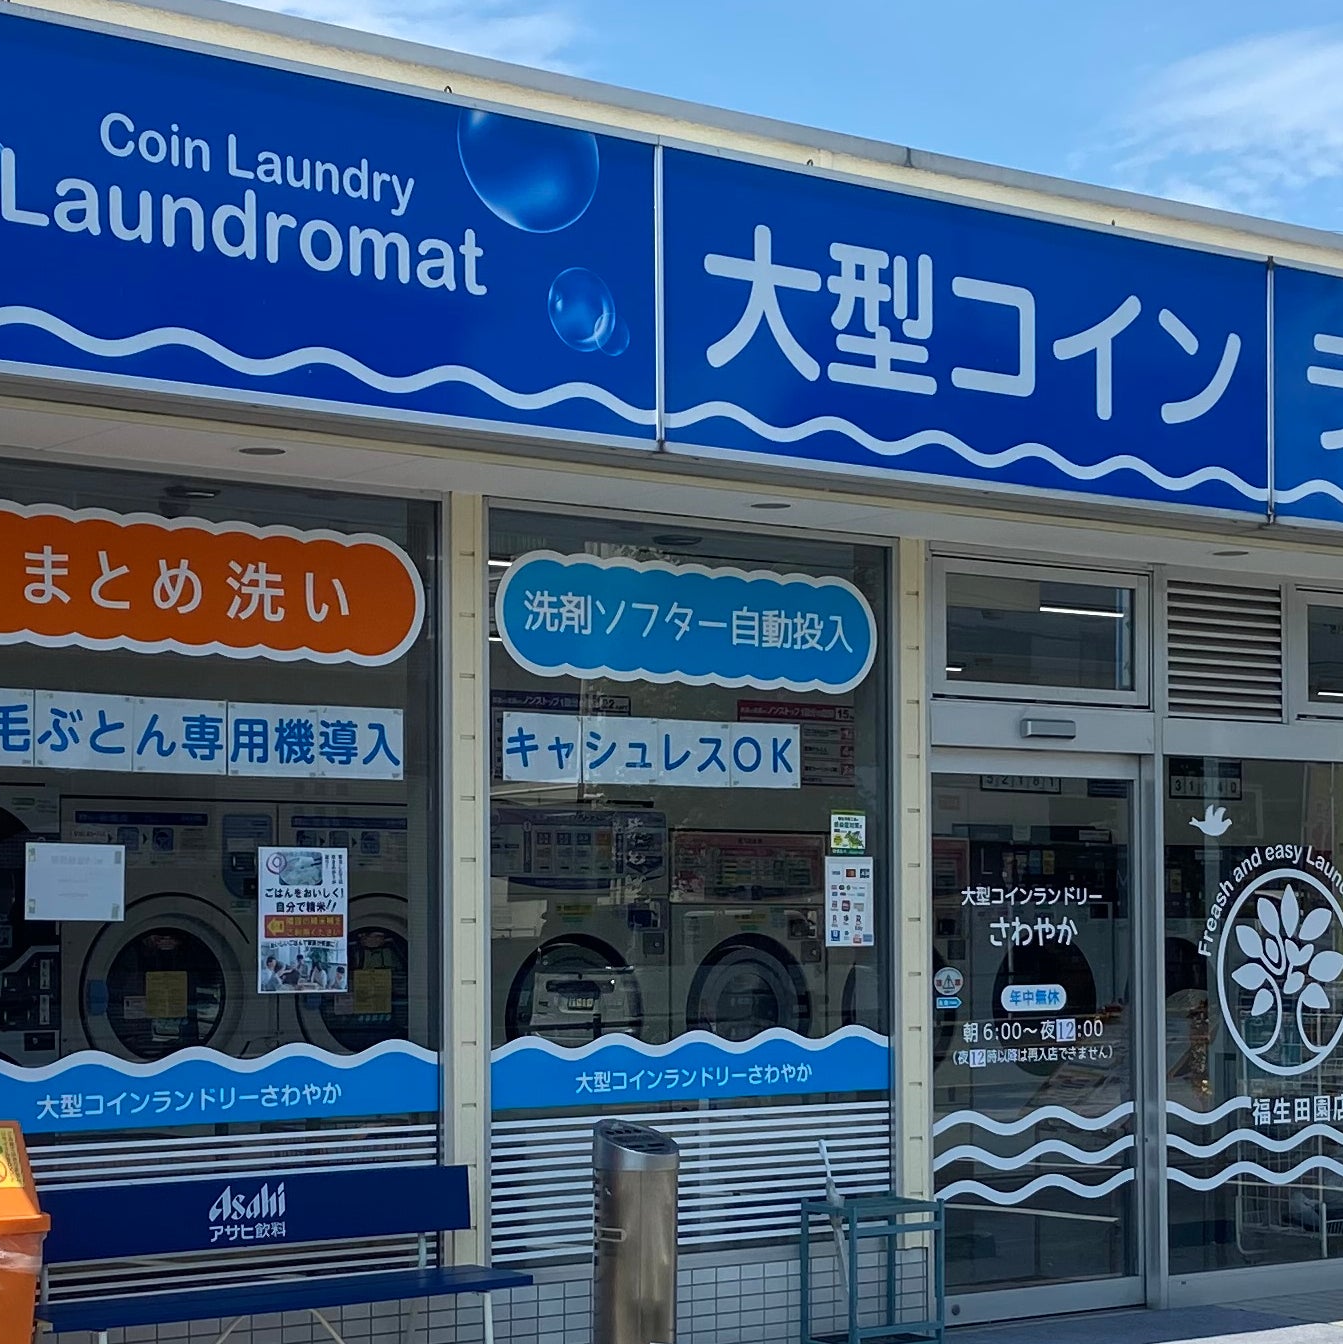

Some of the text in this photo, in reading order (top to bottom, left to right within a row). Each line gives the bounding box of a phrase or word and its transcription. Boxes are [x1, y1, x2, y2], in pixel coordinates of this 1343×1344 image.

[99, 111, 415, 217] Coin Laundry
[0, 146, 489, 297] Laundromat
[702, 223, 1244, 427] 大型コイン
[23, 545, 351, 624] まとめ洗い
[523, 588, 854, 654] 洗剤ソフター自動投入
[961, 886, 1103, 906] 大型コインランドリー
[1197, 881, 1236, 957] Freash
[1232, 847, 1263, 884] and
[1265, 844, 1304, 864] easy
[989, 916, 1079, 947] さわやか
[1008, 989, 1061, 1006] 年中無休
[575, 1061, 814, 1094] 大型コインランドリーさわやか
[35, 1081, 343, 1121] 大型コインランドリーさわやか
[208, 1181, 286, 1223] Asahi
[209, 1221, 287, 1243] アサヒ飲料
